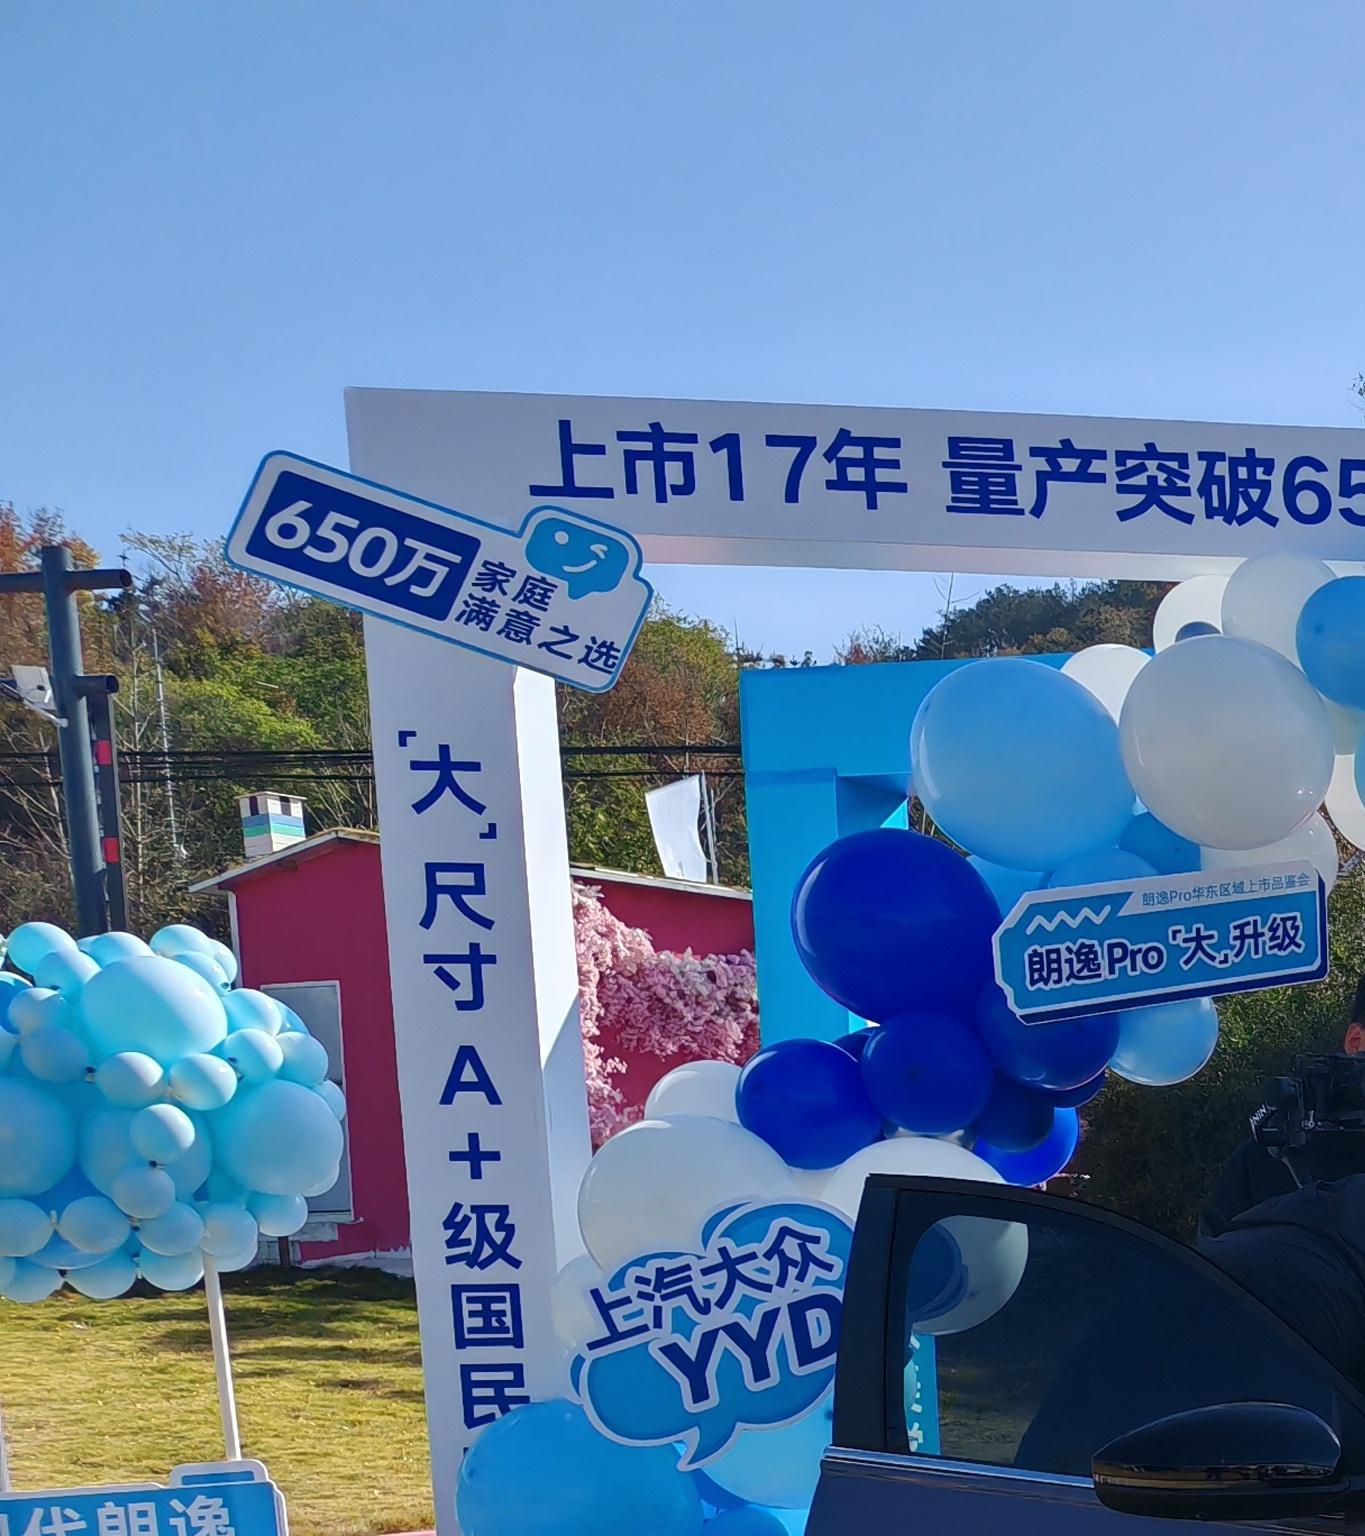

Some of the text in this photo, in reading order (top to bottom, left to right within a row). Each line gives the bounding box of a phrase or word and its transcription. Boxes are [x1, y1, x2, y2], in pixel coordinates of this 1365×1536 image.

[528, 418, 909, 512] 上市17年
[263, 499, 462, 599] 650万
[471, 558, 559, 613] 家庭
[453, 596, 623, 676] 满意之选
[585, 1224, 837, 1352] 上汽大众
